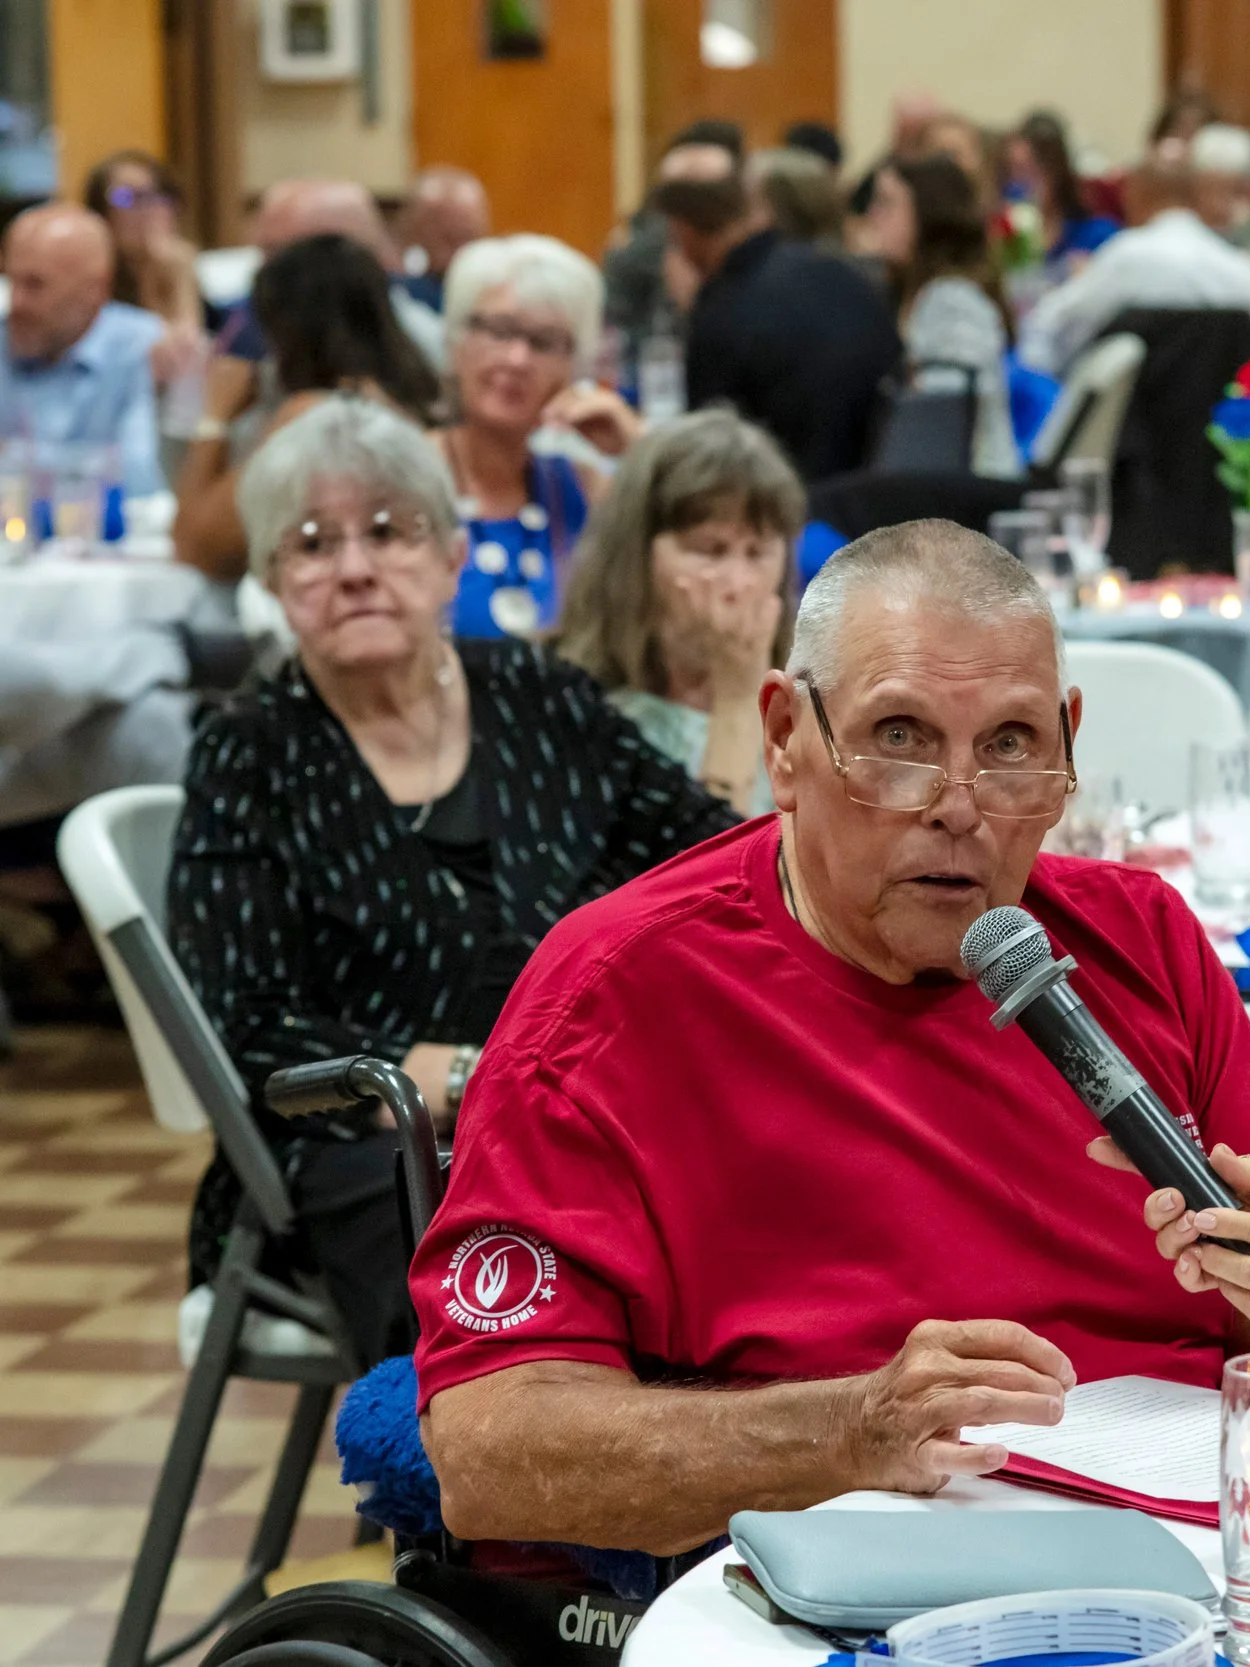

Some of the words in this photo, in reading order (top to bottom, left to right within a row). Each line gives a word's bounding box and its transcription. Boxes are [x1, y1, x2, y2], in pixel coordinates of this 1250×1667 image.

[448, 1223, 498, 1269] NORTHERN
[539, 1245, 557, 1281] STATE
[444, 1298, 499, 1332] VETERANS
[502, 1304, 538, 1330] HOME
